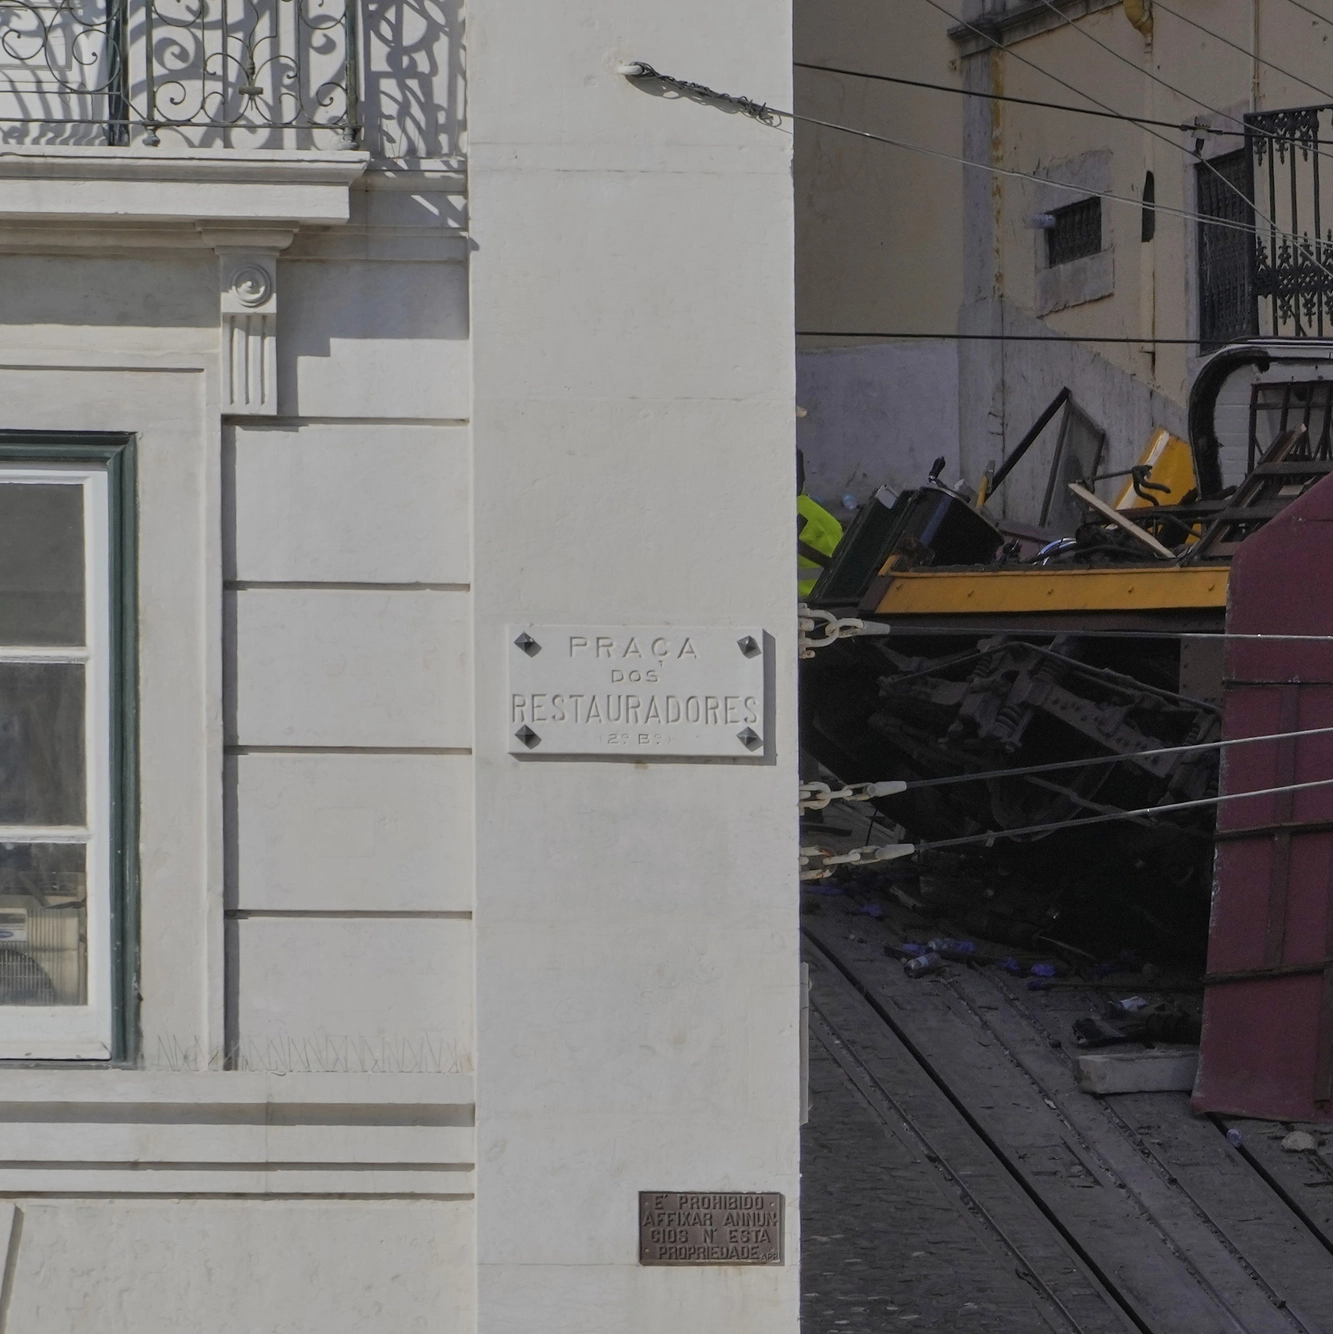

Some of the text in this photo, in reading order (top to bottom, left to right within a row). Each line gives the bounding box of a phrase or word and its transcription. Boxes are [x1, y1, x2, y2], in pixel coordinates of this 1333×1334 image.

[569, 636, 698, 666] PRAÇA
[611, 669, 659, 683] DOS
[511, 693, 759, 725] RESTAURADORES
[679, 1195, 764, 1210] PROHIBIDO
[643, 1211, 713, 1227] AFFIXAR
[651, 1229, 688, 1243] CIOS
[729, 1229, 771, 1243] ESTA
[658, 1245, 760, 1260] PROPRIEDADE
